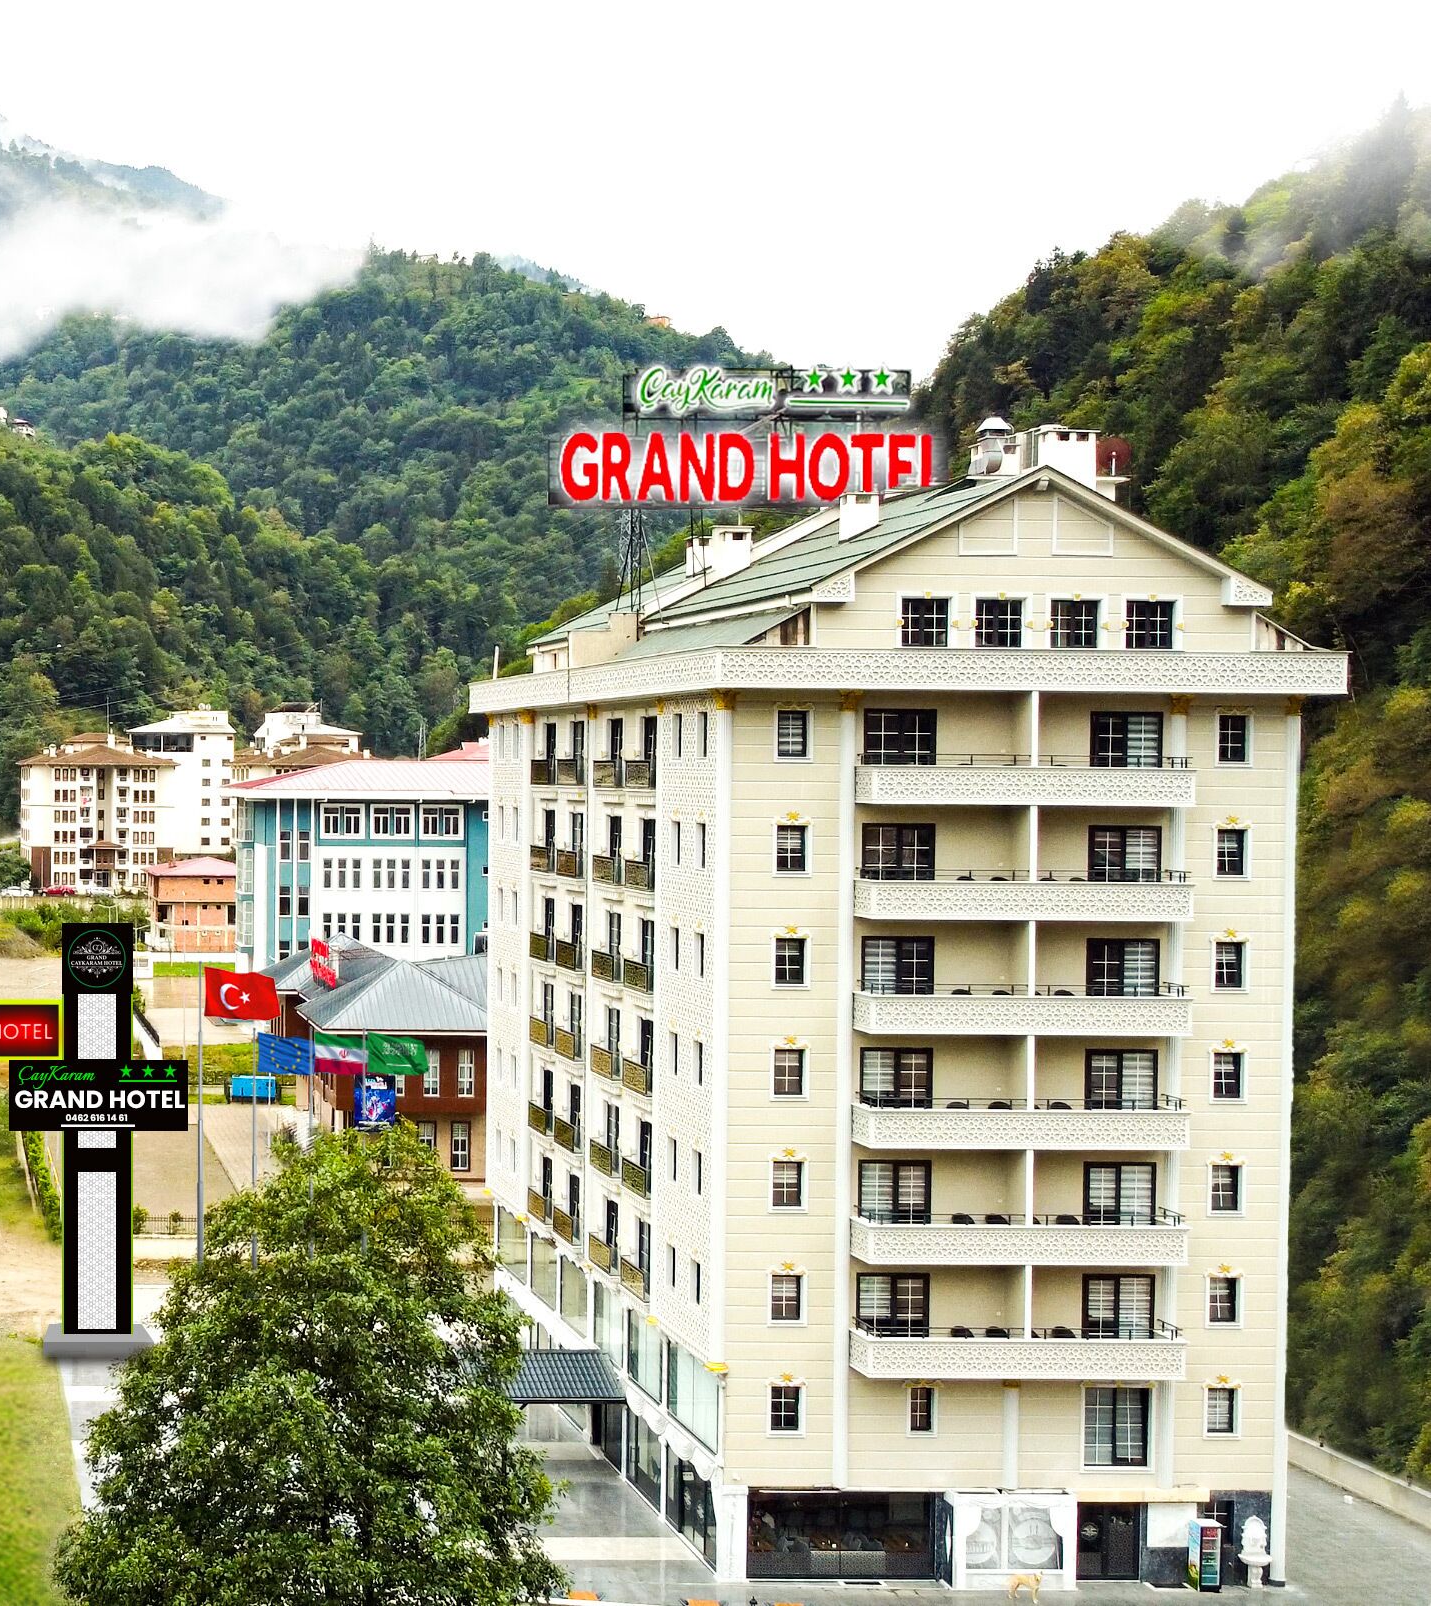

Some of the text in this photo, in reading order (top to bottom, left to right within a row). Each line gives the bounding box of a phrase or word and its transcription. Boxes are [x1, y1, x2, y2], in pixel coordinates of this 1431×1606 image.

[639, 367, 774, 411] ÇayKaram
[560, 431, 756, 502] GRAND
[18, 1065, 96, 1090] ÇayKaram
[14, 1089, 186, 1109] GRAND HOTEL
[65, 1113, 128, 1122] 0462 616 14 61
